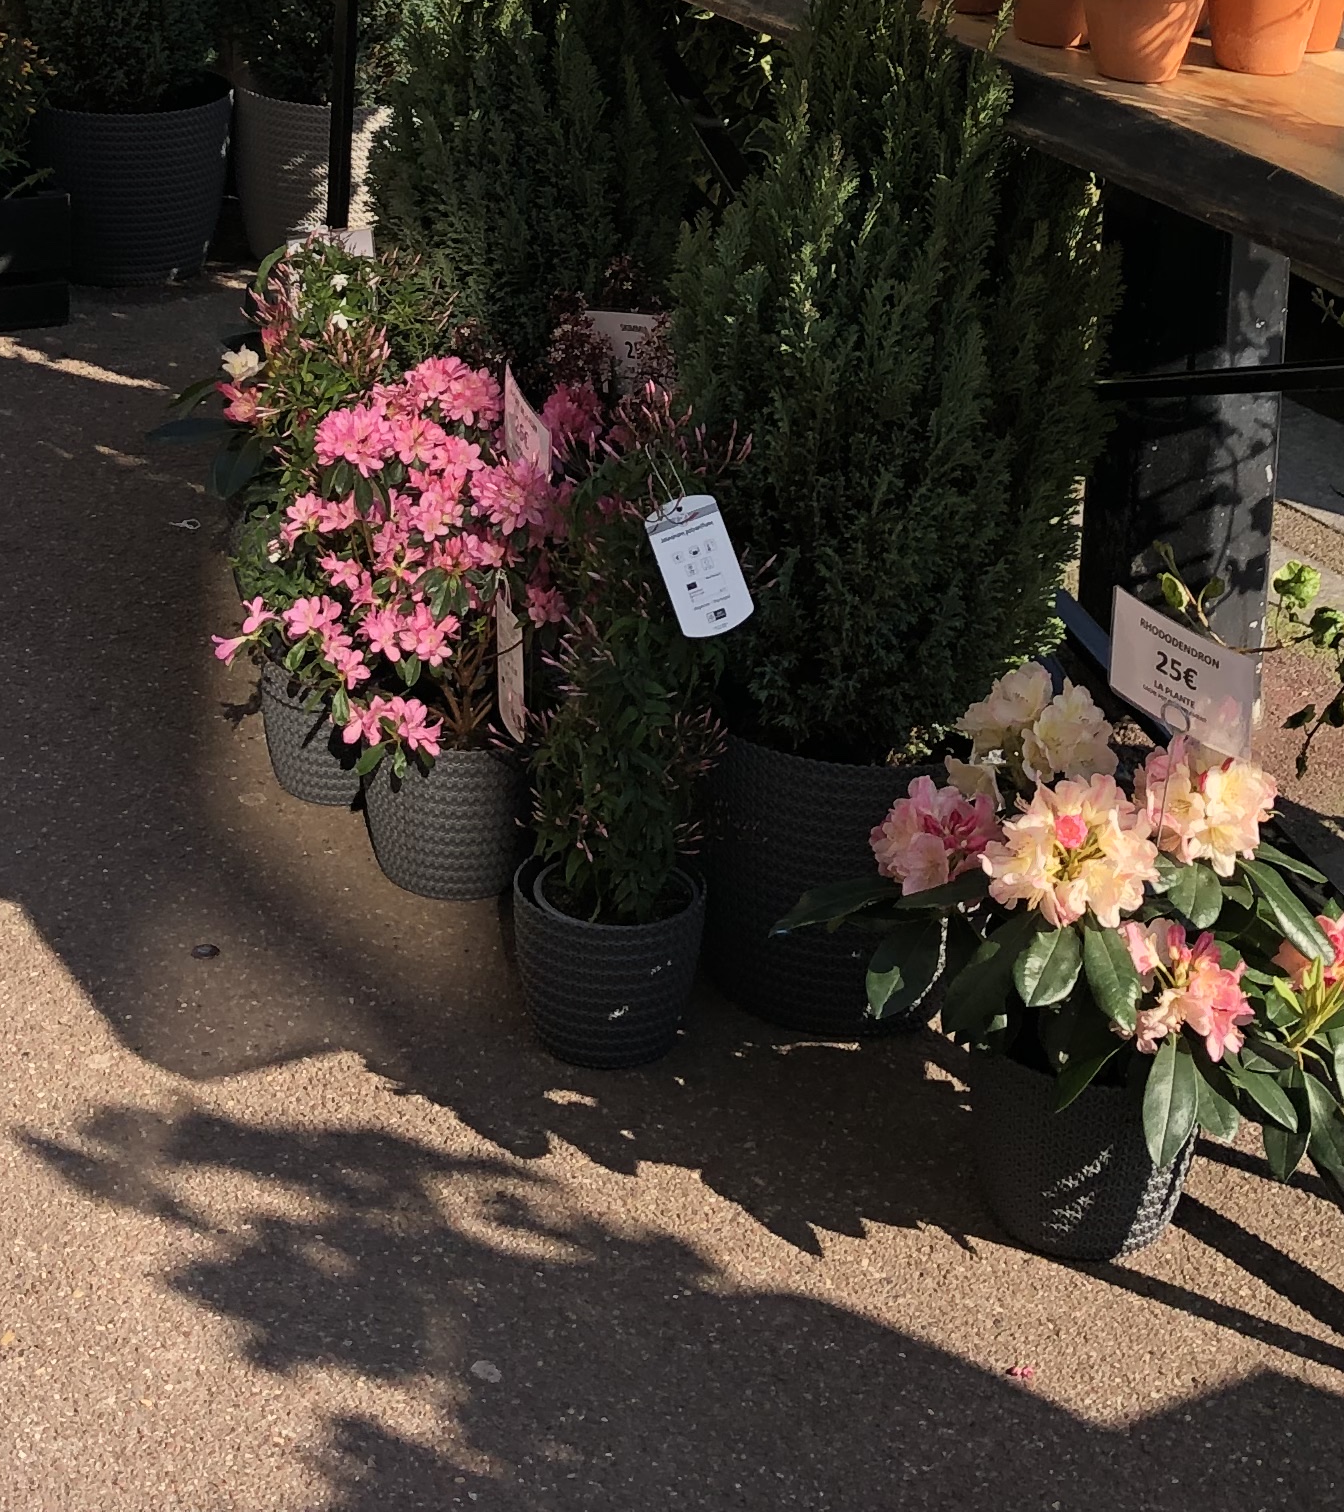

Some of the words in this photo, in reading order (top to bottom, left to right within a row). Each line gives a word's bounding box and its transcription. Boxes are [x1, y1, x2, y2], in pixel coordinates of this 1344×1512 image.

[1139, 617, 1220, 669] RHODODENDRON
[1156, 650, 1198, 690] 25€
[1153, 680, 1164, 692] LA
[1164, 685, 1196, 708] PLANTE
